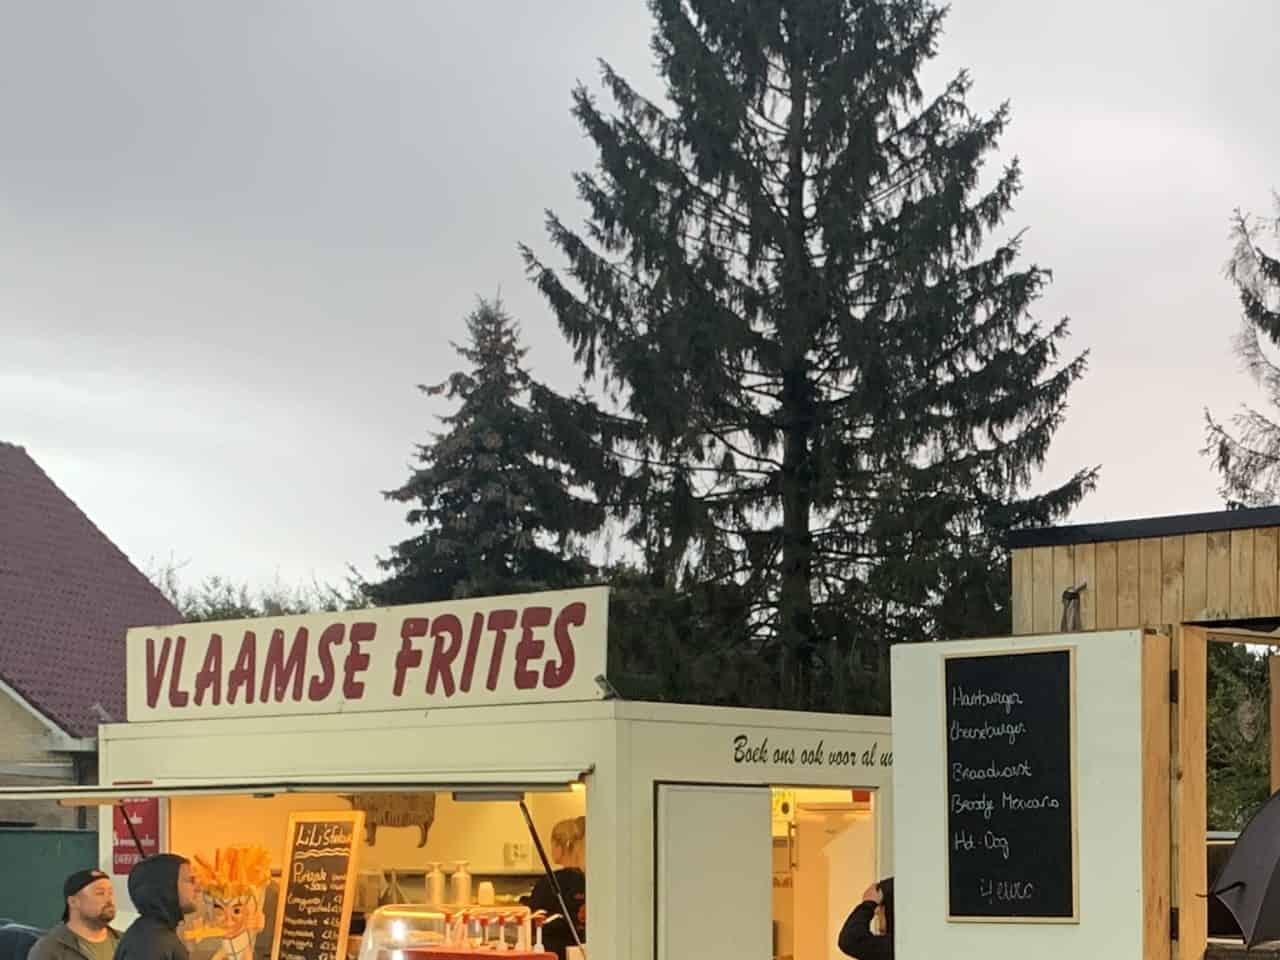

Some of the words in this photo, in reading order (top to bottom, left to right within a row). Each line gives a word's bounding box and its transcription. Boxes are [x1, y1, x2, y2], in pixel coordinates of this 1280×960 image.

[146, 622, 376, 708] VLAAMSE
[393, 602, 586, 698] FRITES
[733, 734, 768, 763] Boek
[773, 749, 795, 764] ons
[800, 739, 824, 765] ook
[829, 751, 856, 766] voor
[861, 742, 877, 766] al
